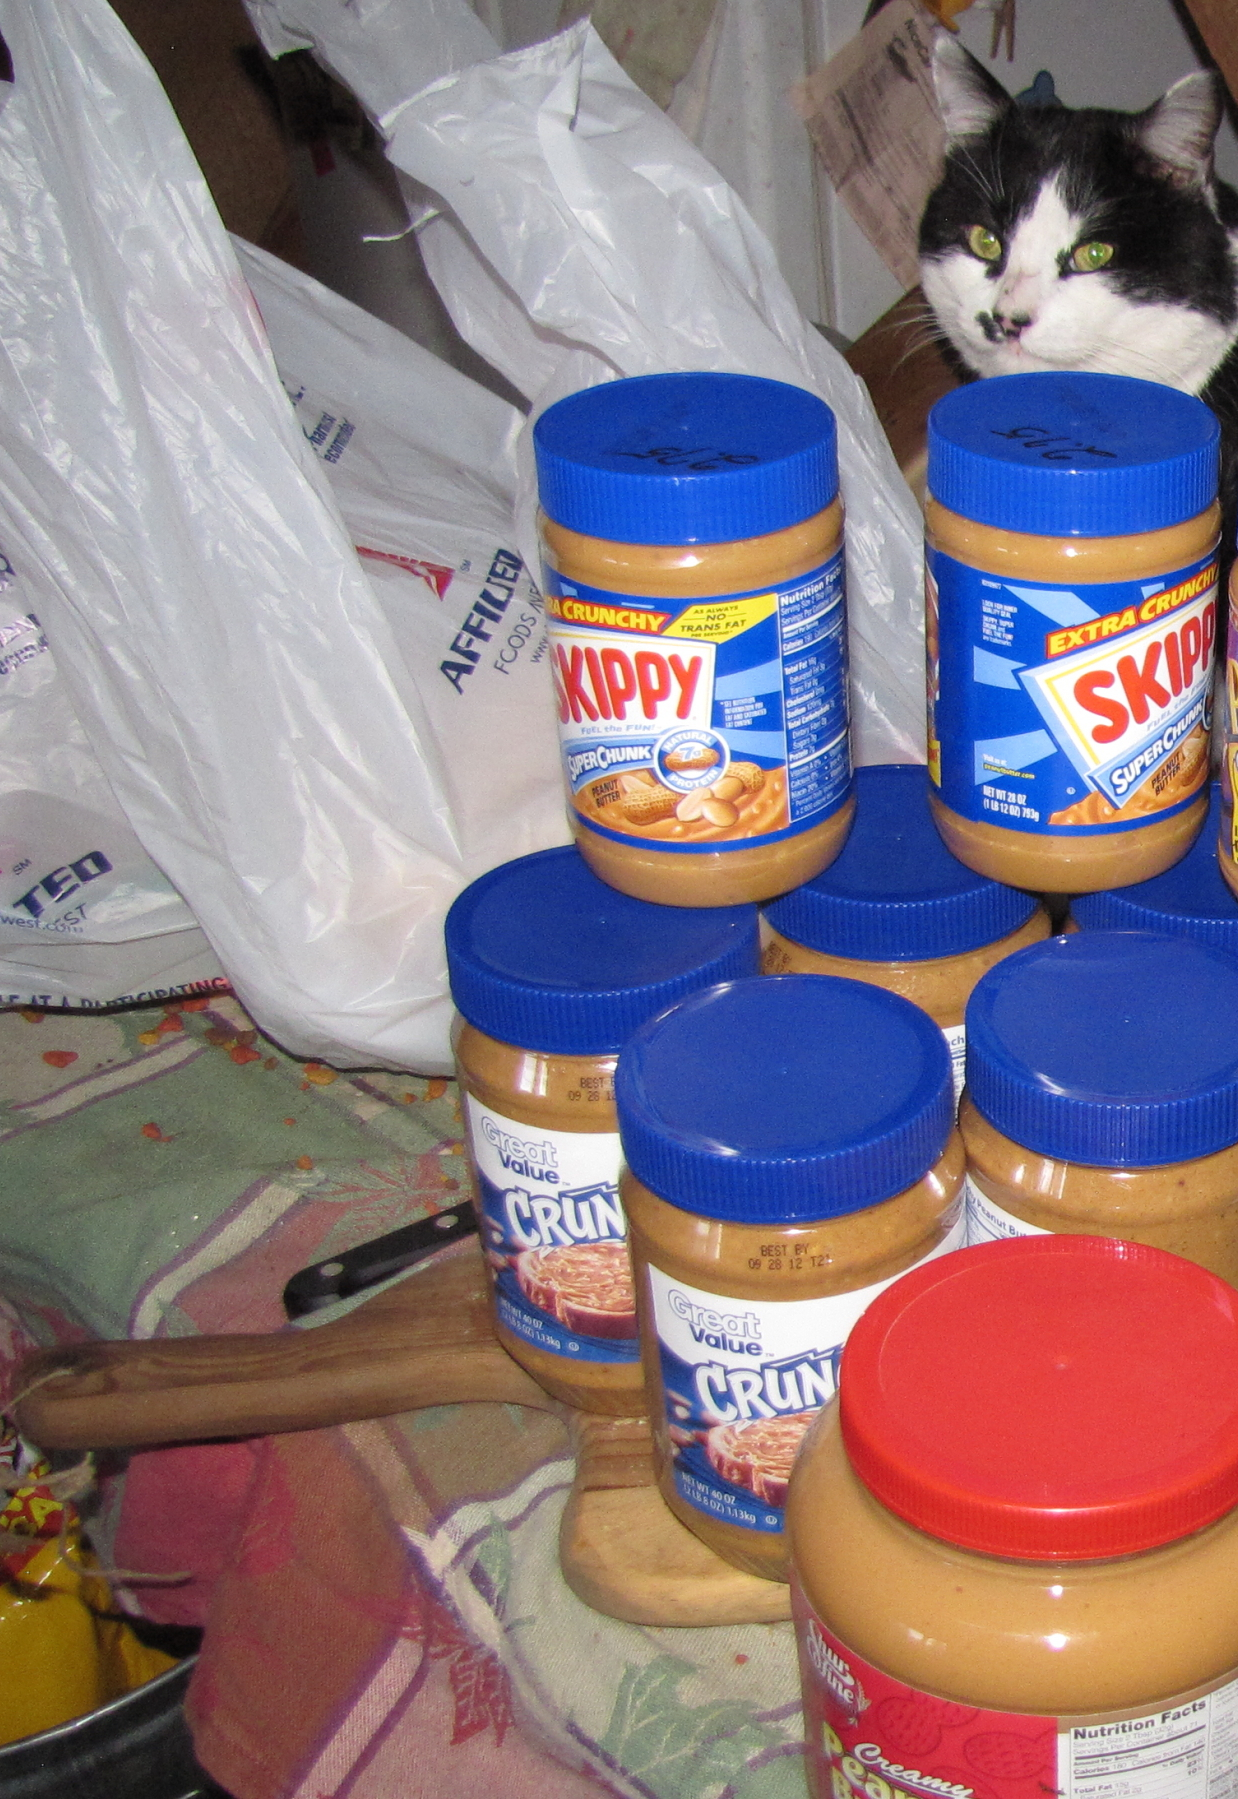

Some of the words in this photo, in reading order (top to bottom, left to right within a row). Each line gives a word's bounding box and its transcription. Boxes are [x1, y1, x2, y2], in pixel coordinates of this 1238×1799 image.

[706, 605, 739, 614] ALWAYS
[780, 581, 824, 607] Nutrition
[1049, 609, 1136, 655] EXTRA
[1140, 565, 1216, 621] CRUNCHY
[562, 599, 666, 632] CRUNCHY
[680, 621, 721, 632] TRANS
[725, 619, 746, 630] FAT
[706, 613, 726, 621] NO
[494, 612, 538, 675] FOODS
[663, 731, 711, 750] NATURAL
[670, 769, 718, 788] PROTEIN
[1152, 752, 1180, 789] PEANUT
[1155, 763, 1181, 796] BUTTER
[592, 779, 618, 797] PEANUT
[596, 791, 621, 808] BUTTER
[1022, 807, 1040, 822] 793g
[481, 1116, 559, 1168] Great
[501, 1151, 560, 1185] Value
[667, 1289, 762, 1338] Great
[690, 1323, 763, 1356] Value
[696, 1358, 839, 1421] CRUN
[727, 1506, 756, 1524] 1.13kg
[1073, 1719, 1155, 1740] Nutrition
[1161, 1700, 1206, 1724] Facts
